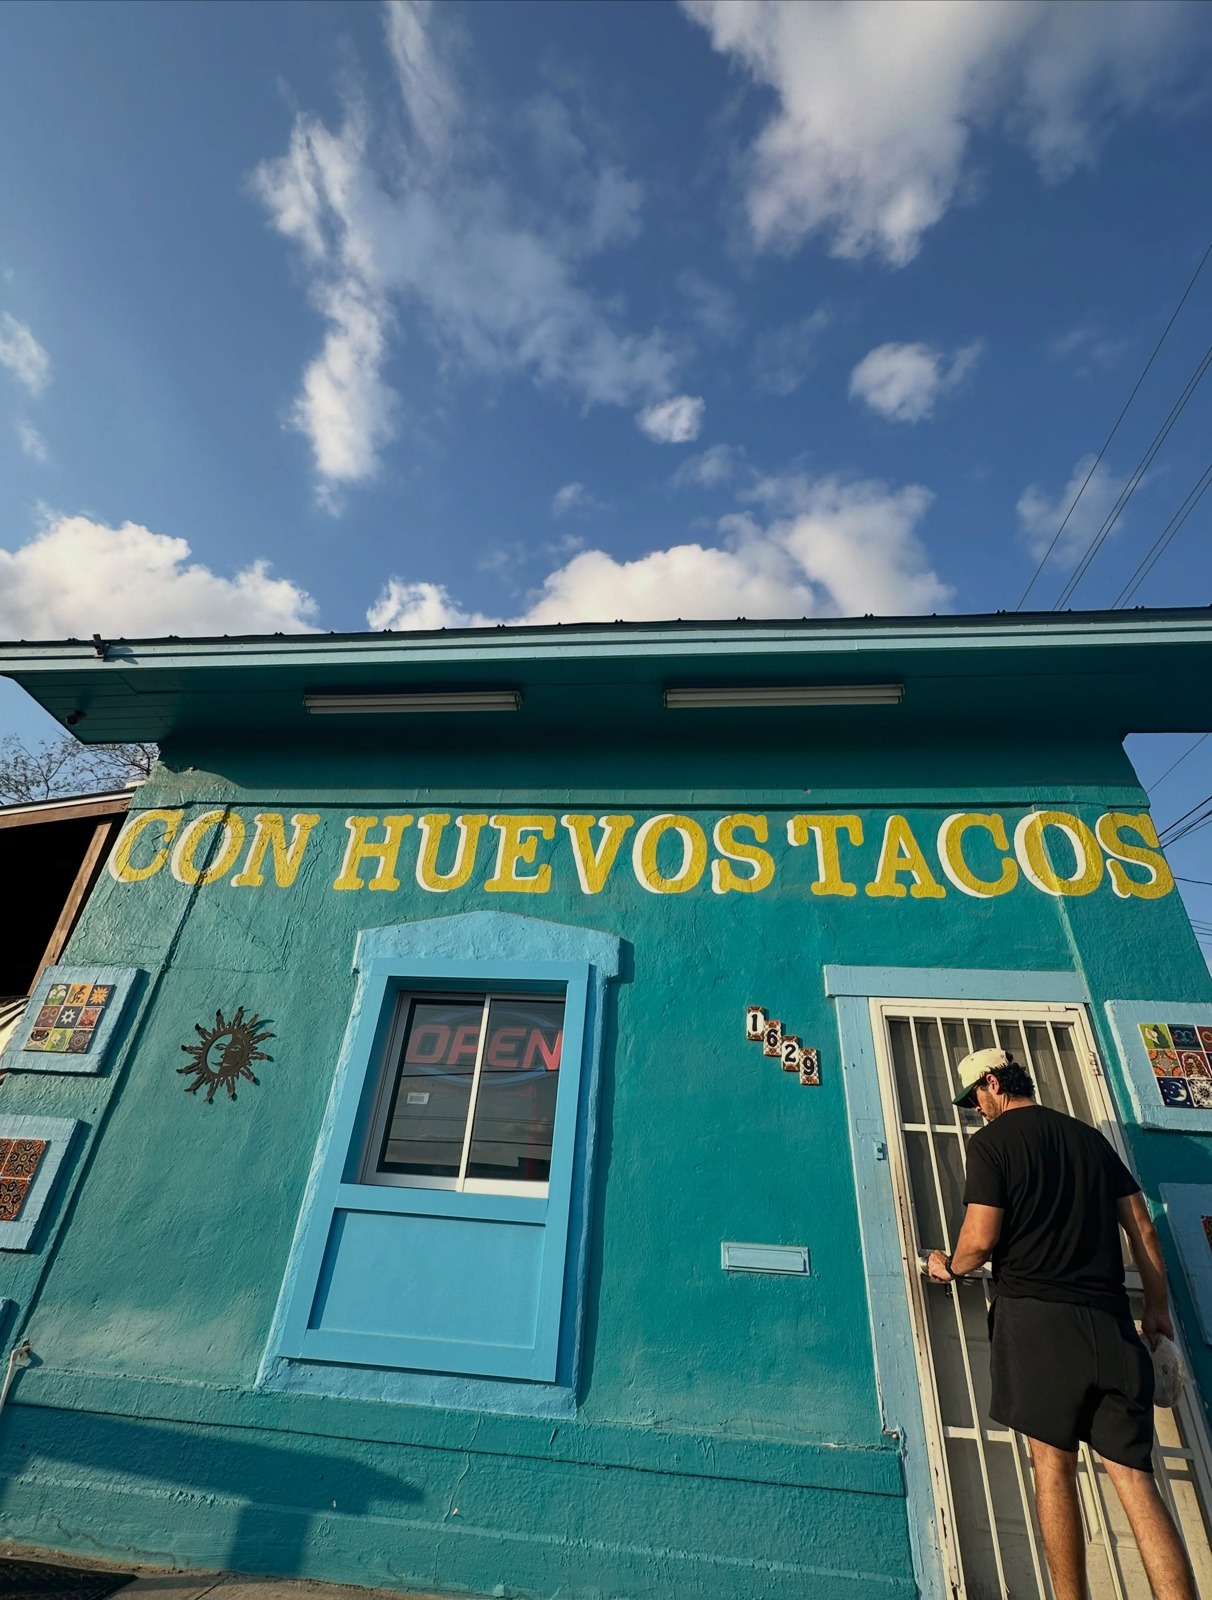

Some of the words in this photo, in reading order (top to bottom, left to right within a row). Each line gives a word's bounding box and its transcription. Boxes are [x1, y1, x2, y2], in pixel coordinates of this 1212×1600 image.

[109, 809, 320, 888] CON
[333, 812, 776, 895] HUEVOS
[786, 810, 1175, 899] TACOS
[405, 1024, 563, 1070] OPEN
[751, 1013, 815, 1076] 1629
